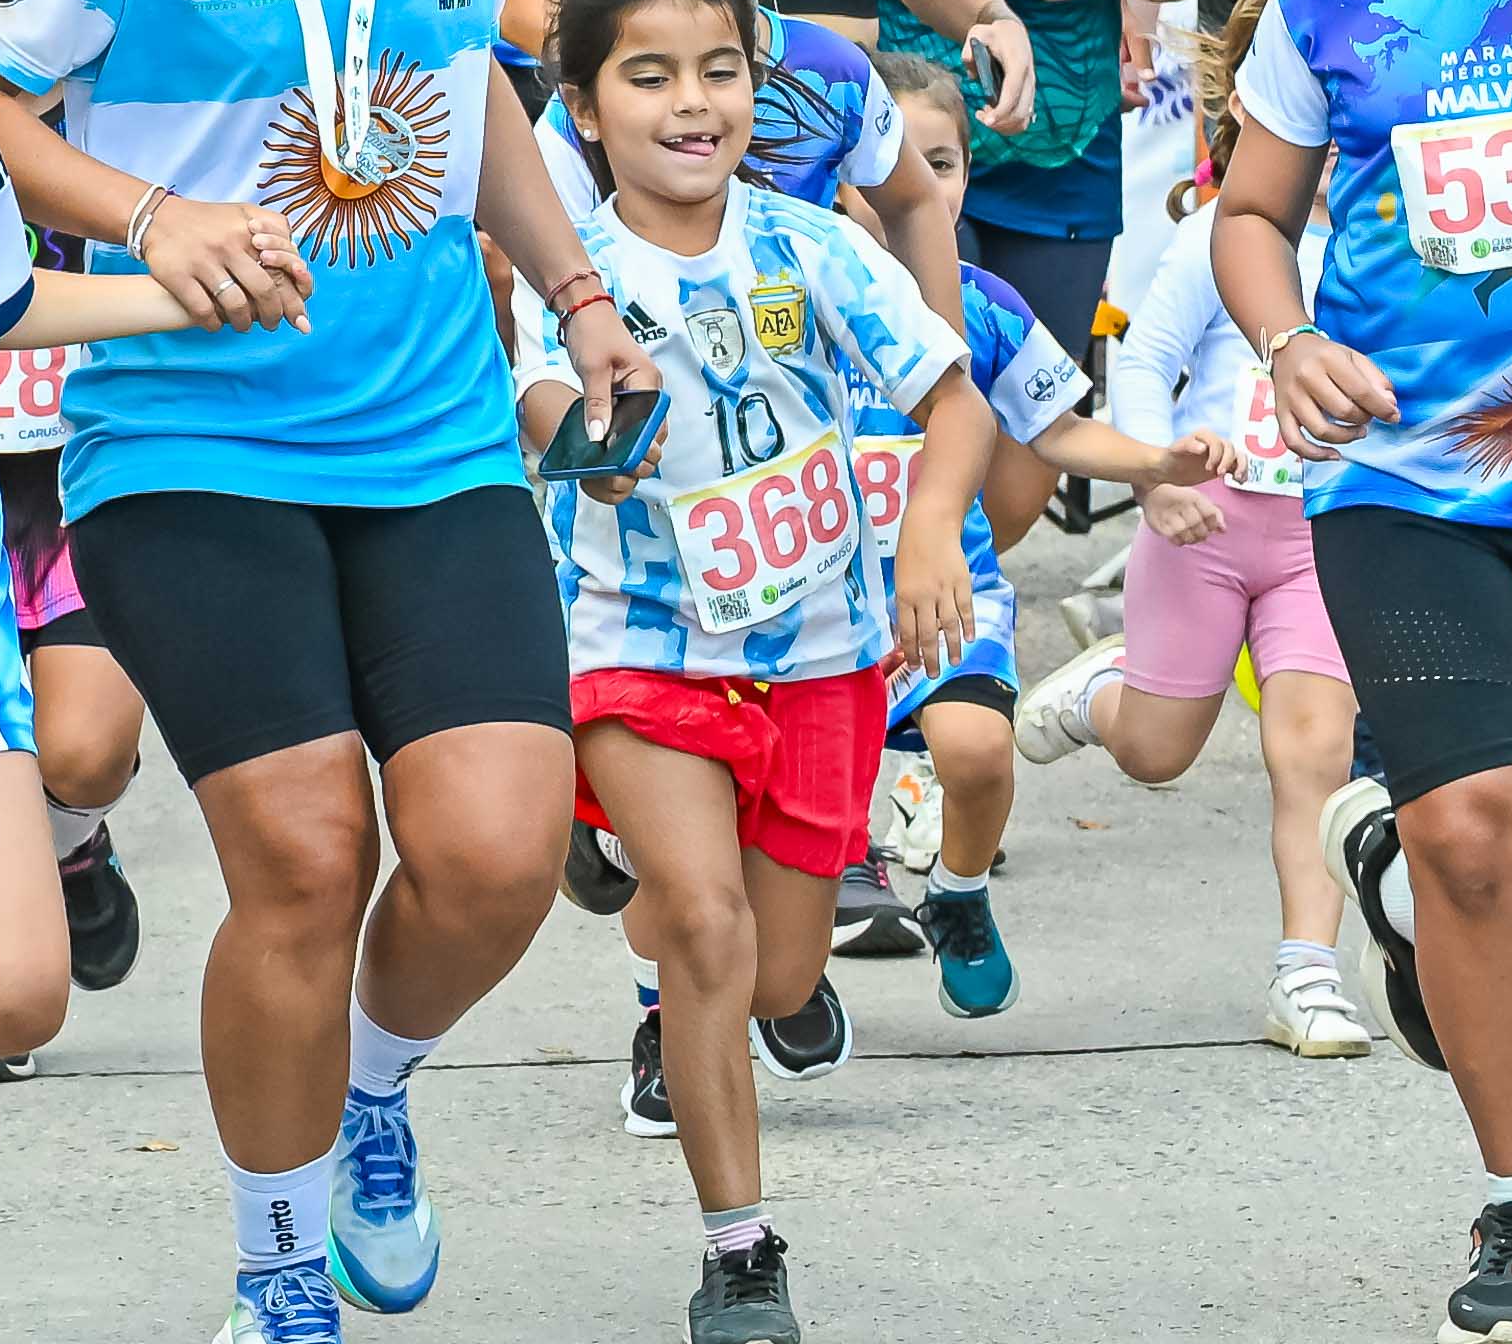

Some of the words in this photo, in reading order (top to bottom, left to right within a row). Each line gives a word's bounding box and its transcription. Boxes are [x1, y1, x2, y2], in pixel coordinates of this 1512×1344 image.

[759, 307, 797, 337] AFA
[704, 392, 786, 477] 10
[688, 448, 849, 591] 368
[816, 540, 853, 574] CARUSO
